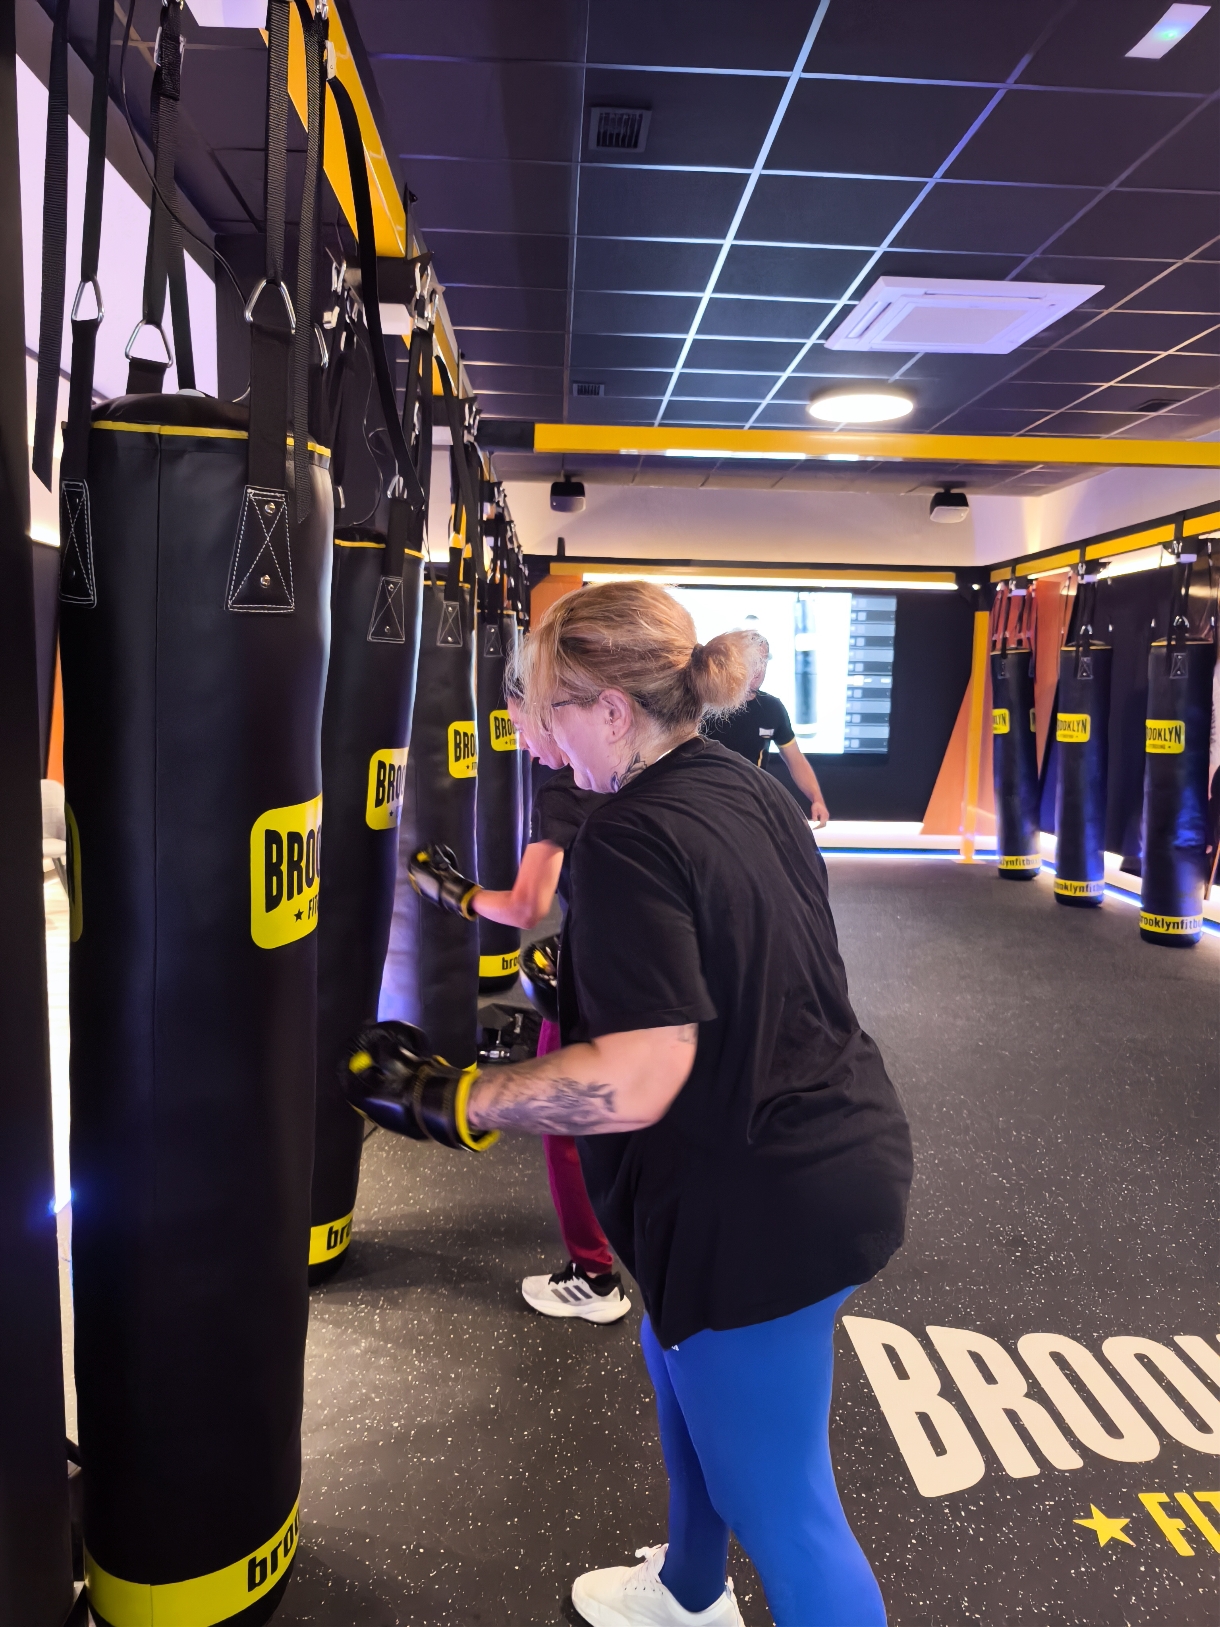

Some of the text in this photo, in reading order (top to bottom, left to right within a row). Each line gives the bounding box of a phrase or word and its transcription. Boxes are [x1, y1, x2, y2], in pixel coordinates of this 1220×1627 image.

[1057, 719, 1087, 734] OOKLYN
[1146, 725, 1182, 744] OOKLYN
[502, 955, 519, 970] bro
